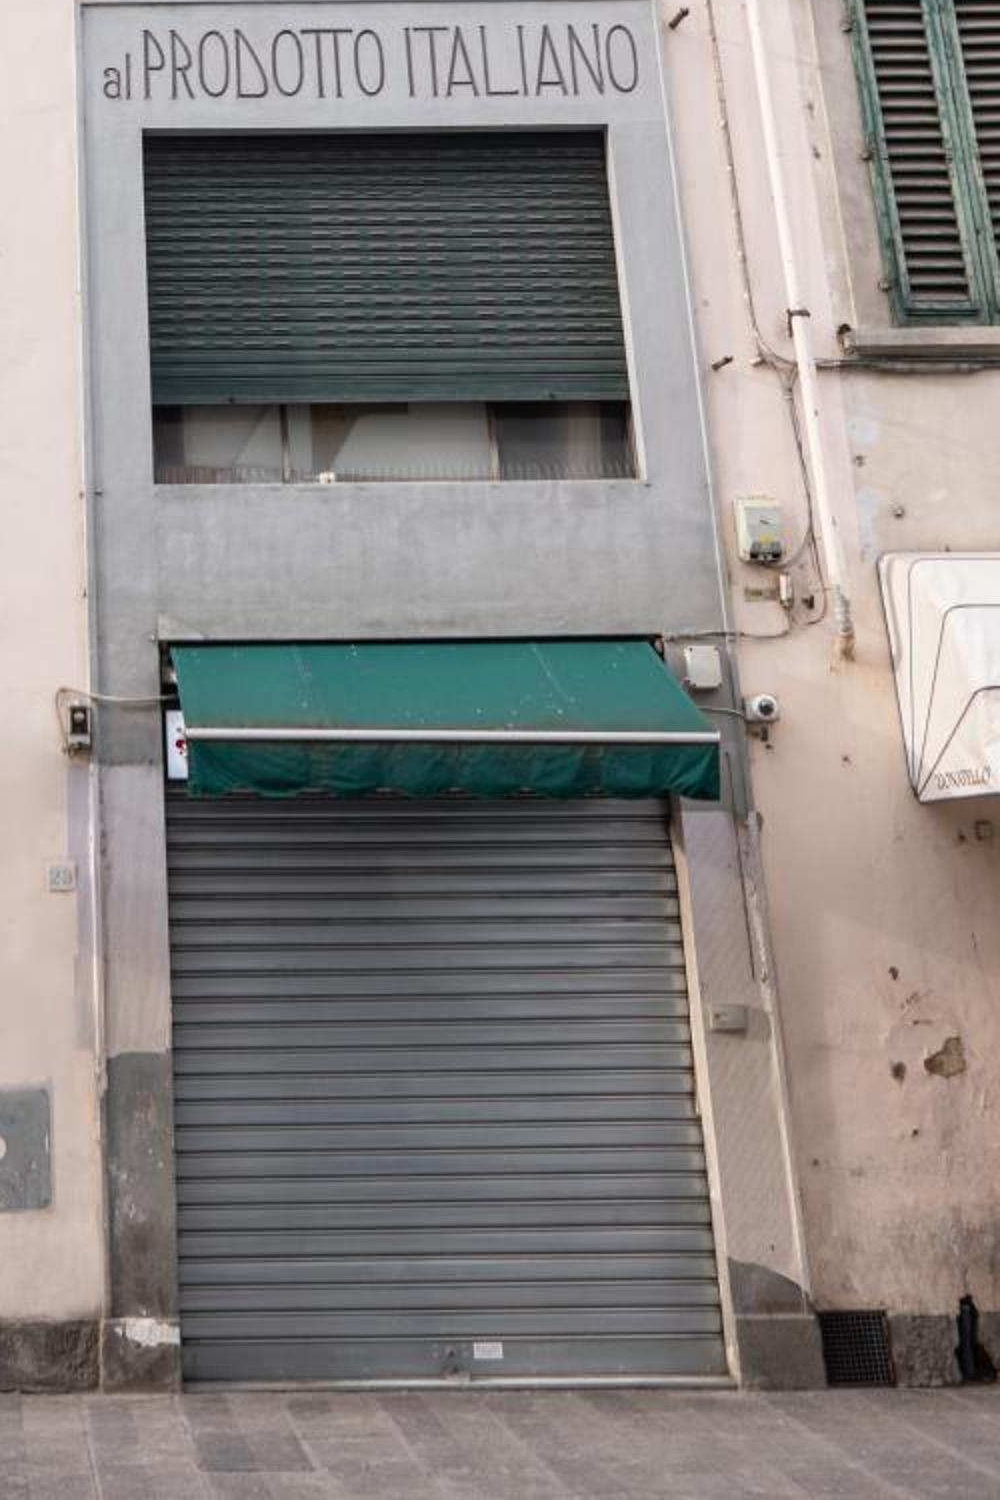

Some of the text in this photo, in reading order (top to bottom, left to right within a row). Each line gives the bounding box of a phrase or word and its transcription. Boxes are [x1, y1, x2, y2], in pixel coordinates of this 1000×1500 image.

[103, 25, 639, 100] al PRODOTTO ITALIANO
